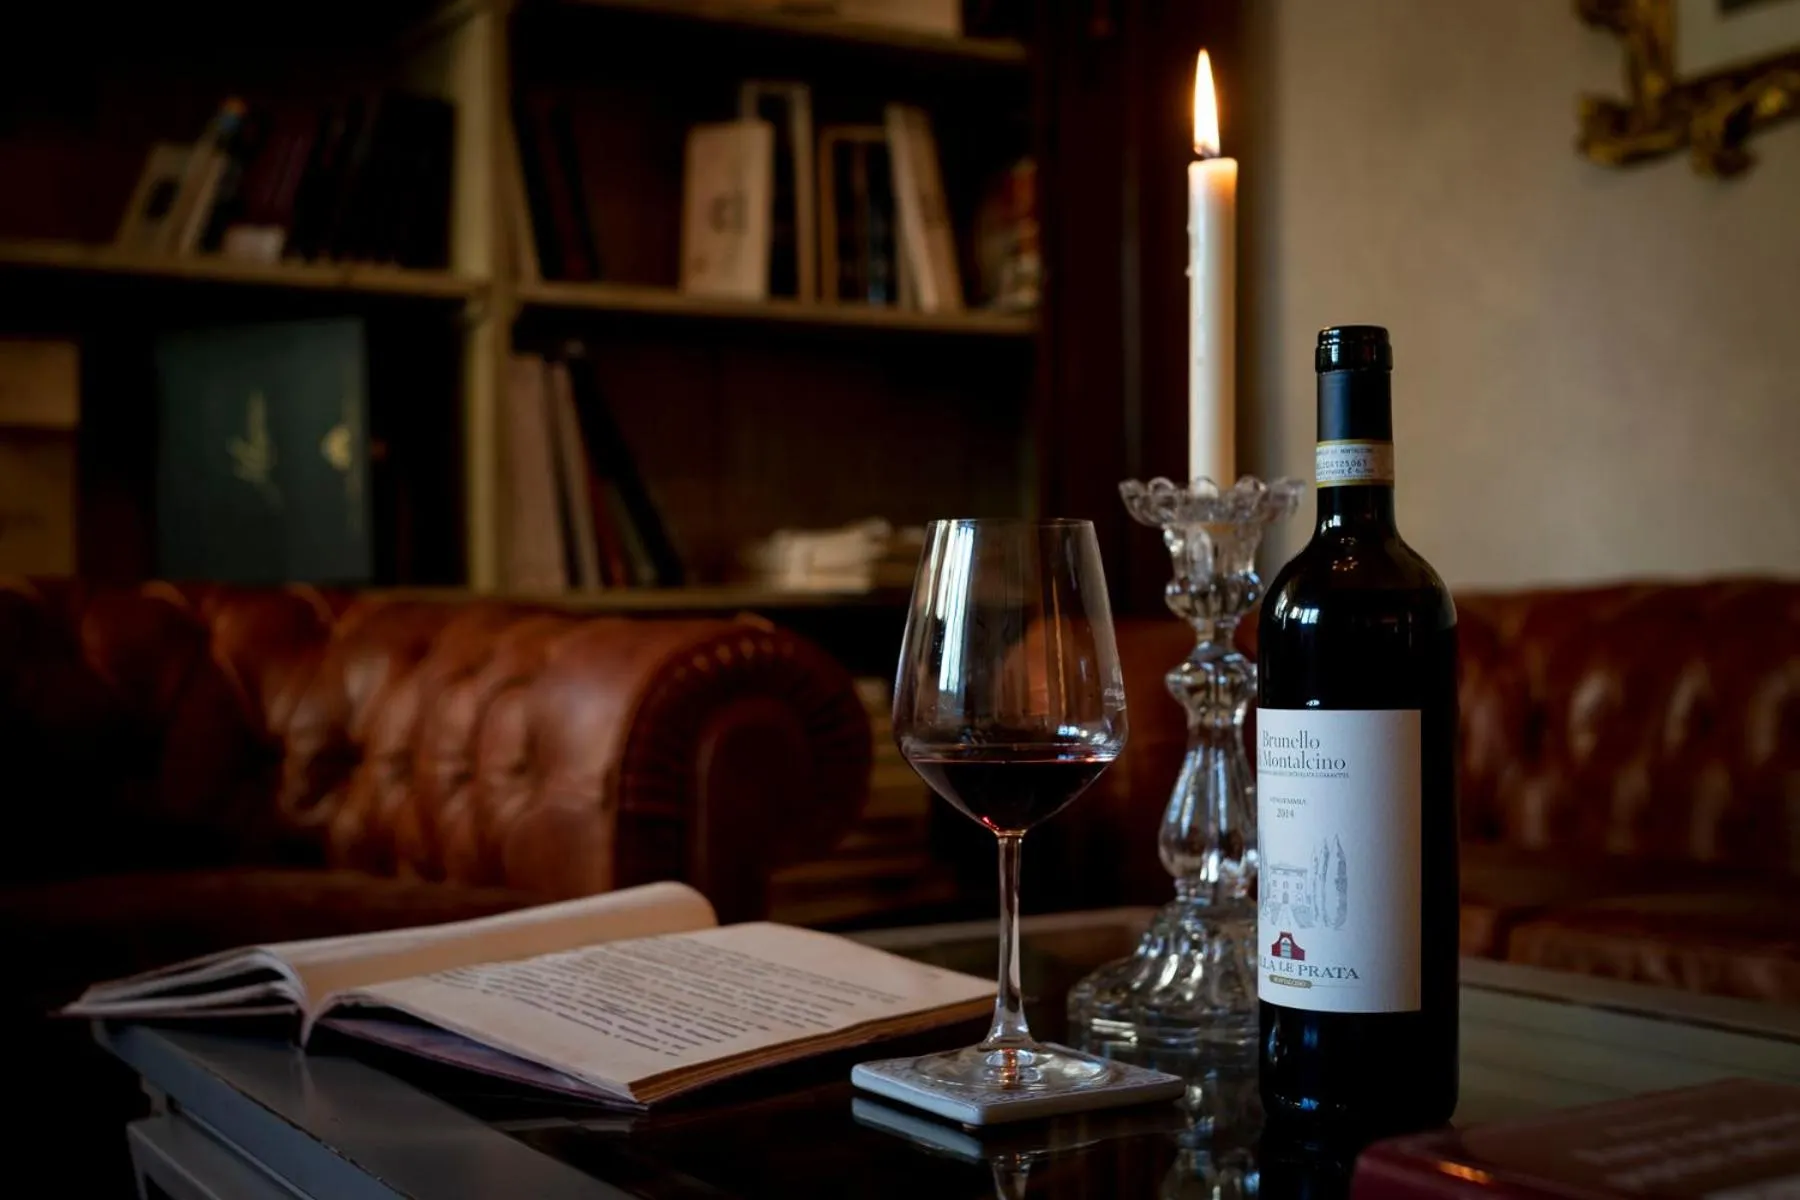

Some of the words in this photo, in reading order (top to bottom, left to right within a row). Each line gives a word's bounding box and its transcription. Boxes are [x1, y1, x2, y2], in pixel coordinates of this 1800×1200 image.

[1262, 729, 1320, 749] Brunello
[1263, 750, 1346, 770] Montalcino
[1276, 808, 1295, 819] 2014
[1279, 960, 1294, 973] LE
[1298, 963, 1360, 980] PRATA
